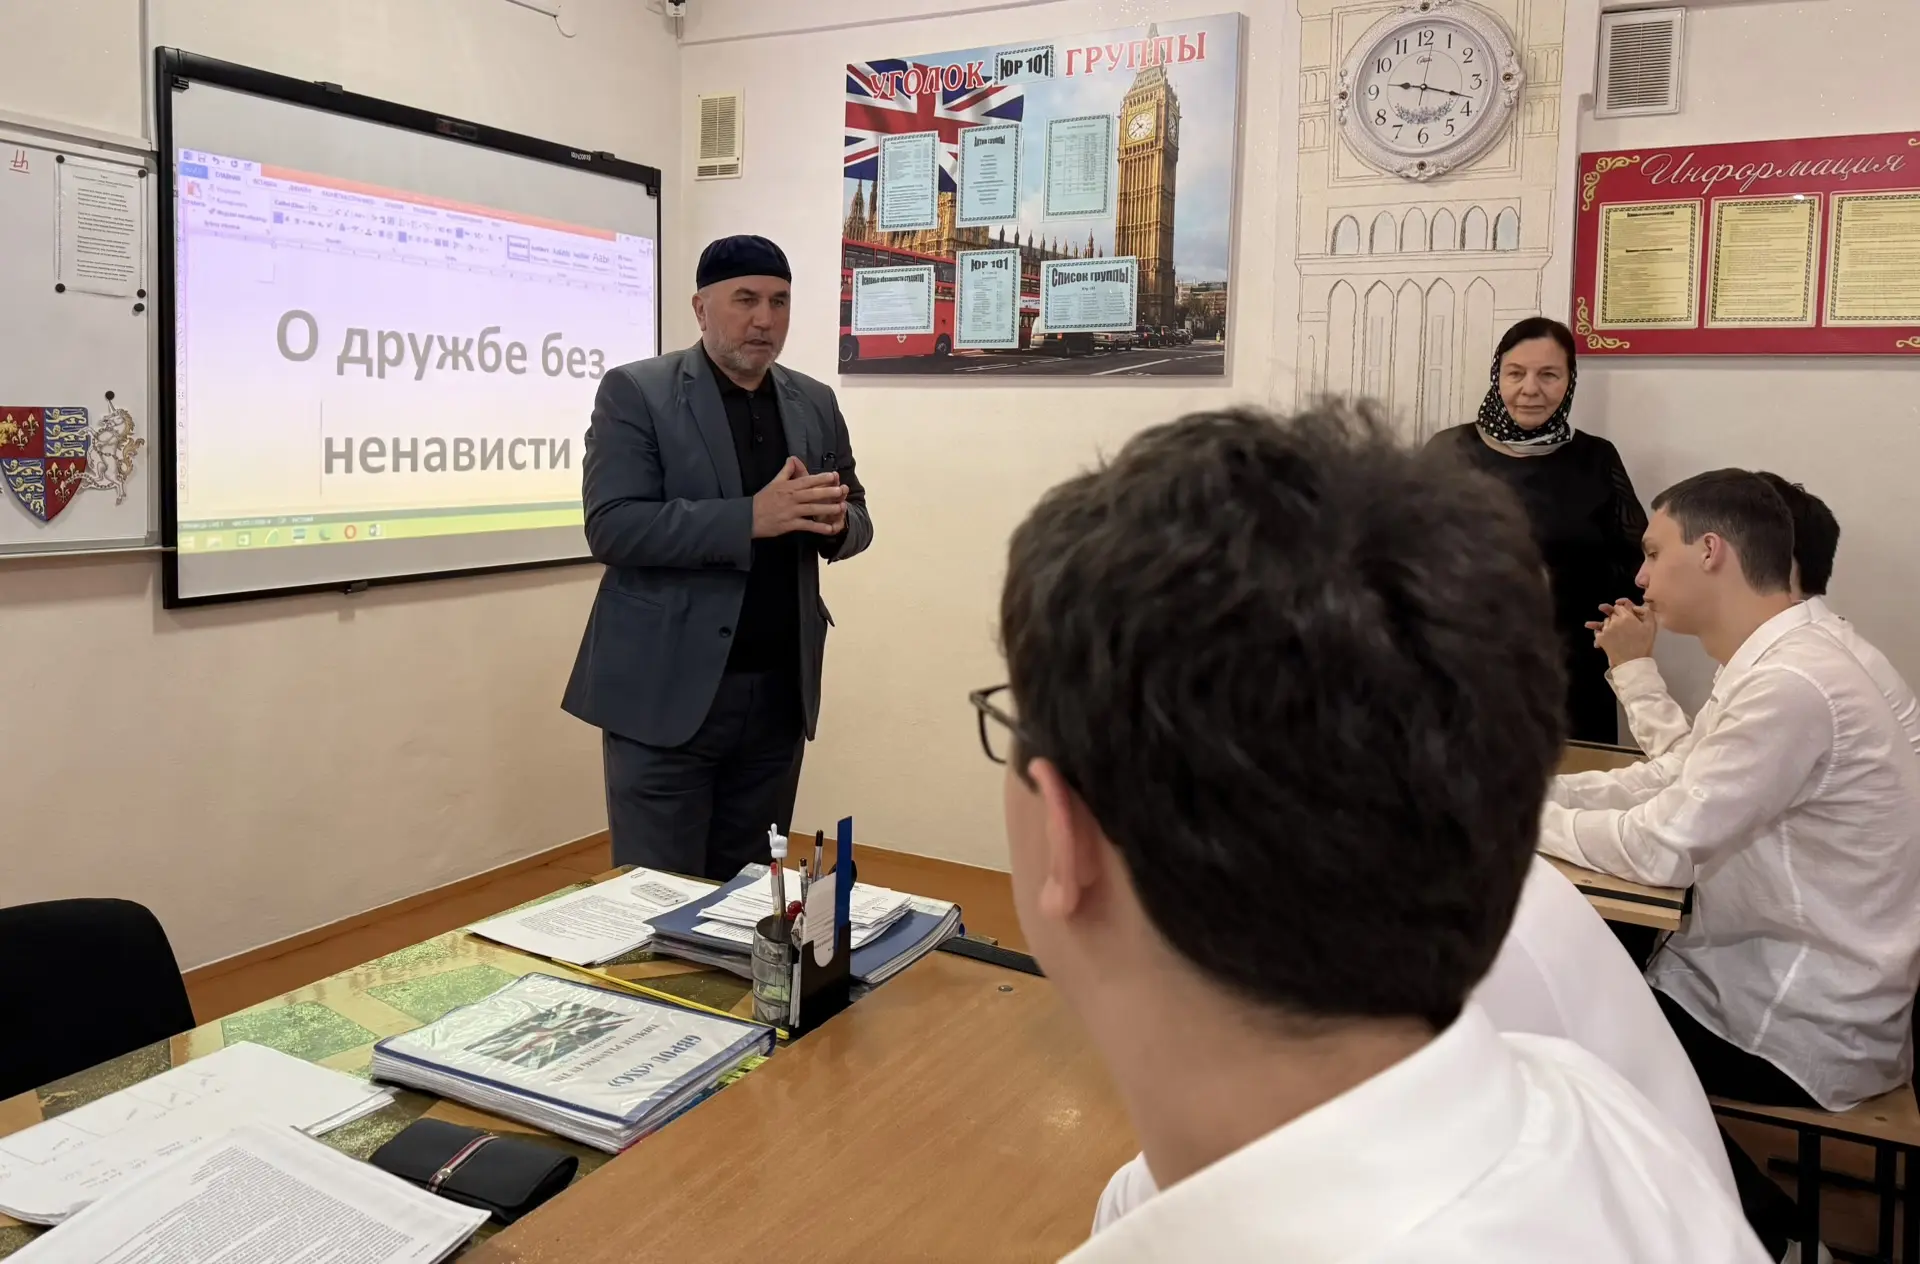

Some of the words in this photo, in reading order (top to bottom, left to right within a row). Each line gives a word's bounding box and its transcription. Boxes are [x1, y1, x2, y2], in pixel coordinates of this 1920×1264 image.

[1418, 30, 1434, 46] 12
[1447, 33, 1452, 48] 1
[1396, 39, 1407, 55] 11
[1463, 48, 1473, 63] 2
[870, 61, 984, 98] УГОЛОК
[1000, 57, 1023, 81] ЮР
[1026, 51, 1049, 76] 101
[1065, 32, 1207, 77] ГРУППЫ
[1376, 58, 1392, 73] 10
[1470, 74, 1482, 90] 3
[1368, 85, 1379, 101] 9
[1460, 100, 1472, 116] 4
[1375, 109, 1386, 125] 8
[1392, 124, 1403, 139] 7
[1418, 127, 1429, 144] 6
[1444, 119, 1454, 136] 5
[1640, 152, 1907, 194] Информация
[991, 257, 1008, 270] 101
[277, 309, 319, 361] О
[336, 325, 527, 381] дружбе
[541, 332, 606, 380] без
[324, 435, 571, 474] ненависти
[654, 1035, 702, 1065] GBPOU
